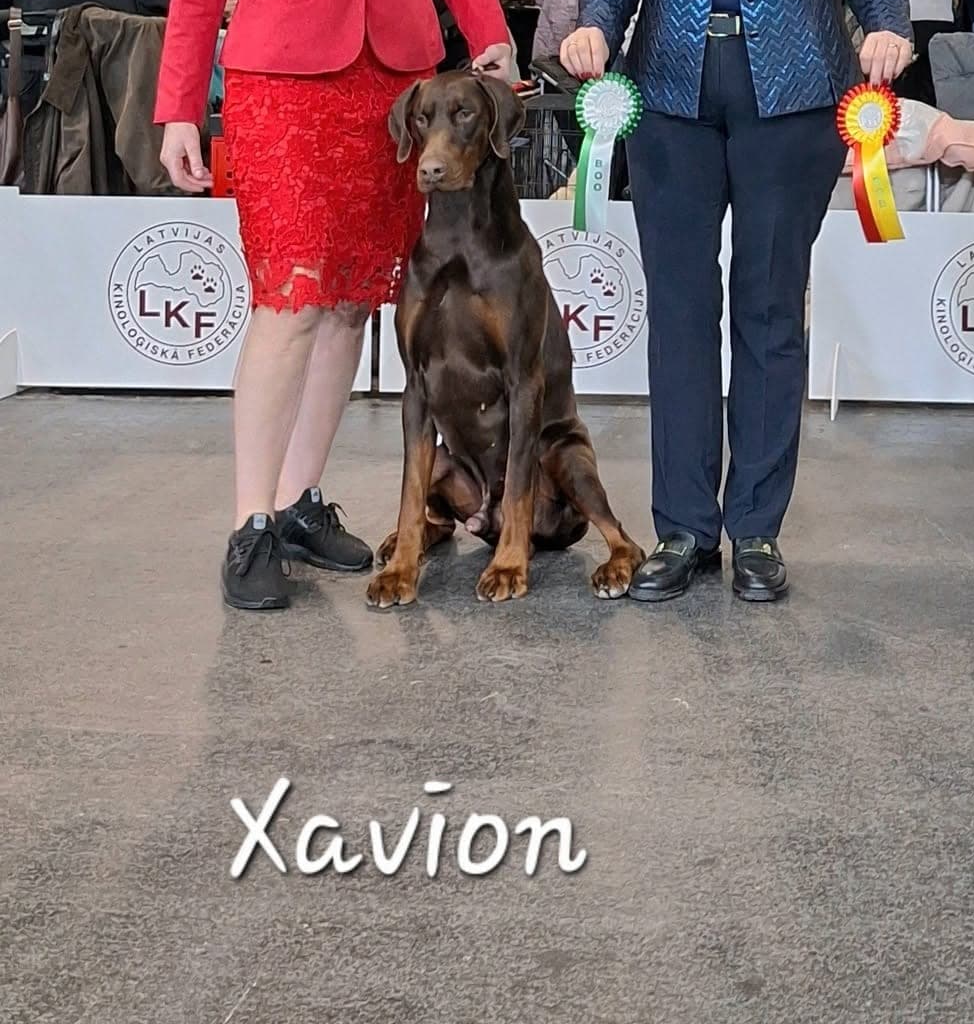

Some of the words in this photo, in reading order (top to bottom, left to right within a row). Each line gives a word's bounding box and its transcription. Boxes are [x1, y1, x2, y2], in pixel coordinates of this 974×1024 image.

[133, 227, 226, 254] LATVIJAS
[545, 232, 626, 259] ATVIJAS
[138, 289, 217, 339] LKF
[560, 303, 616, 342] KF
